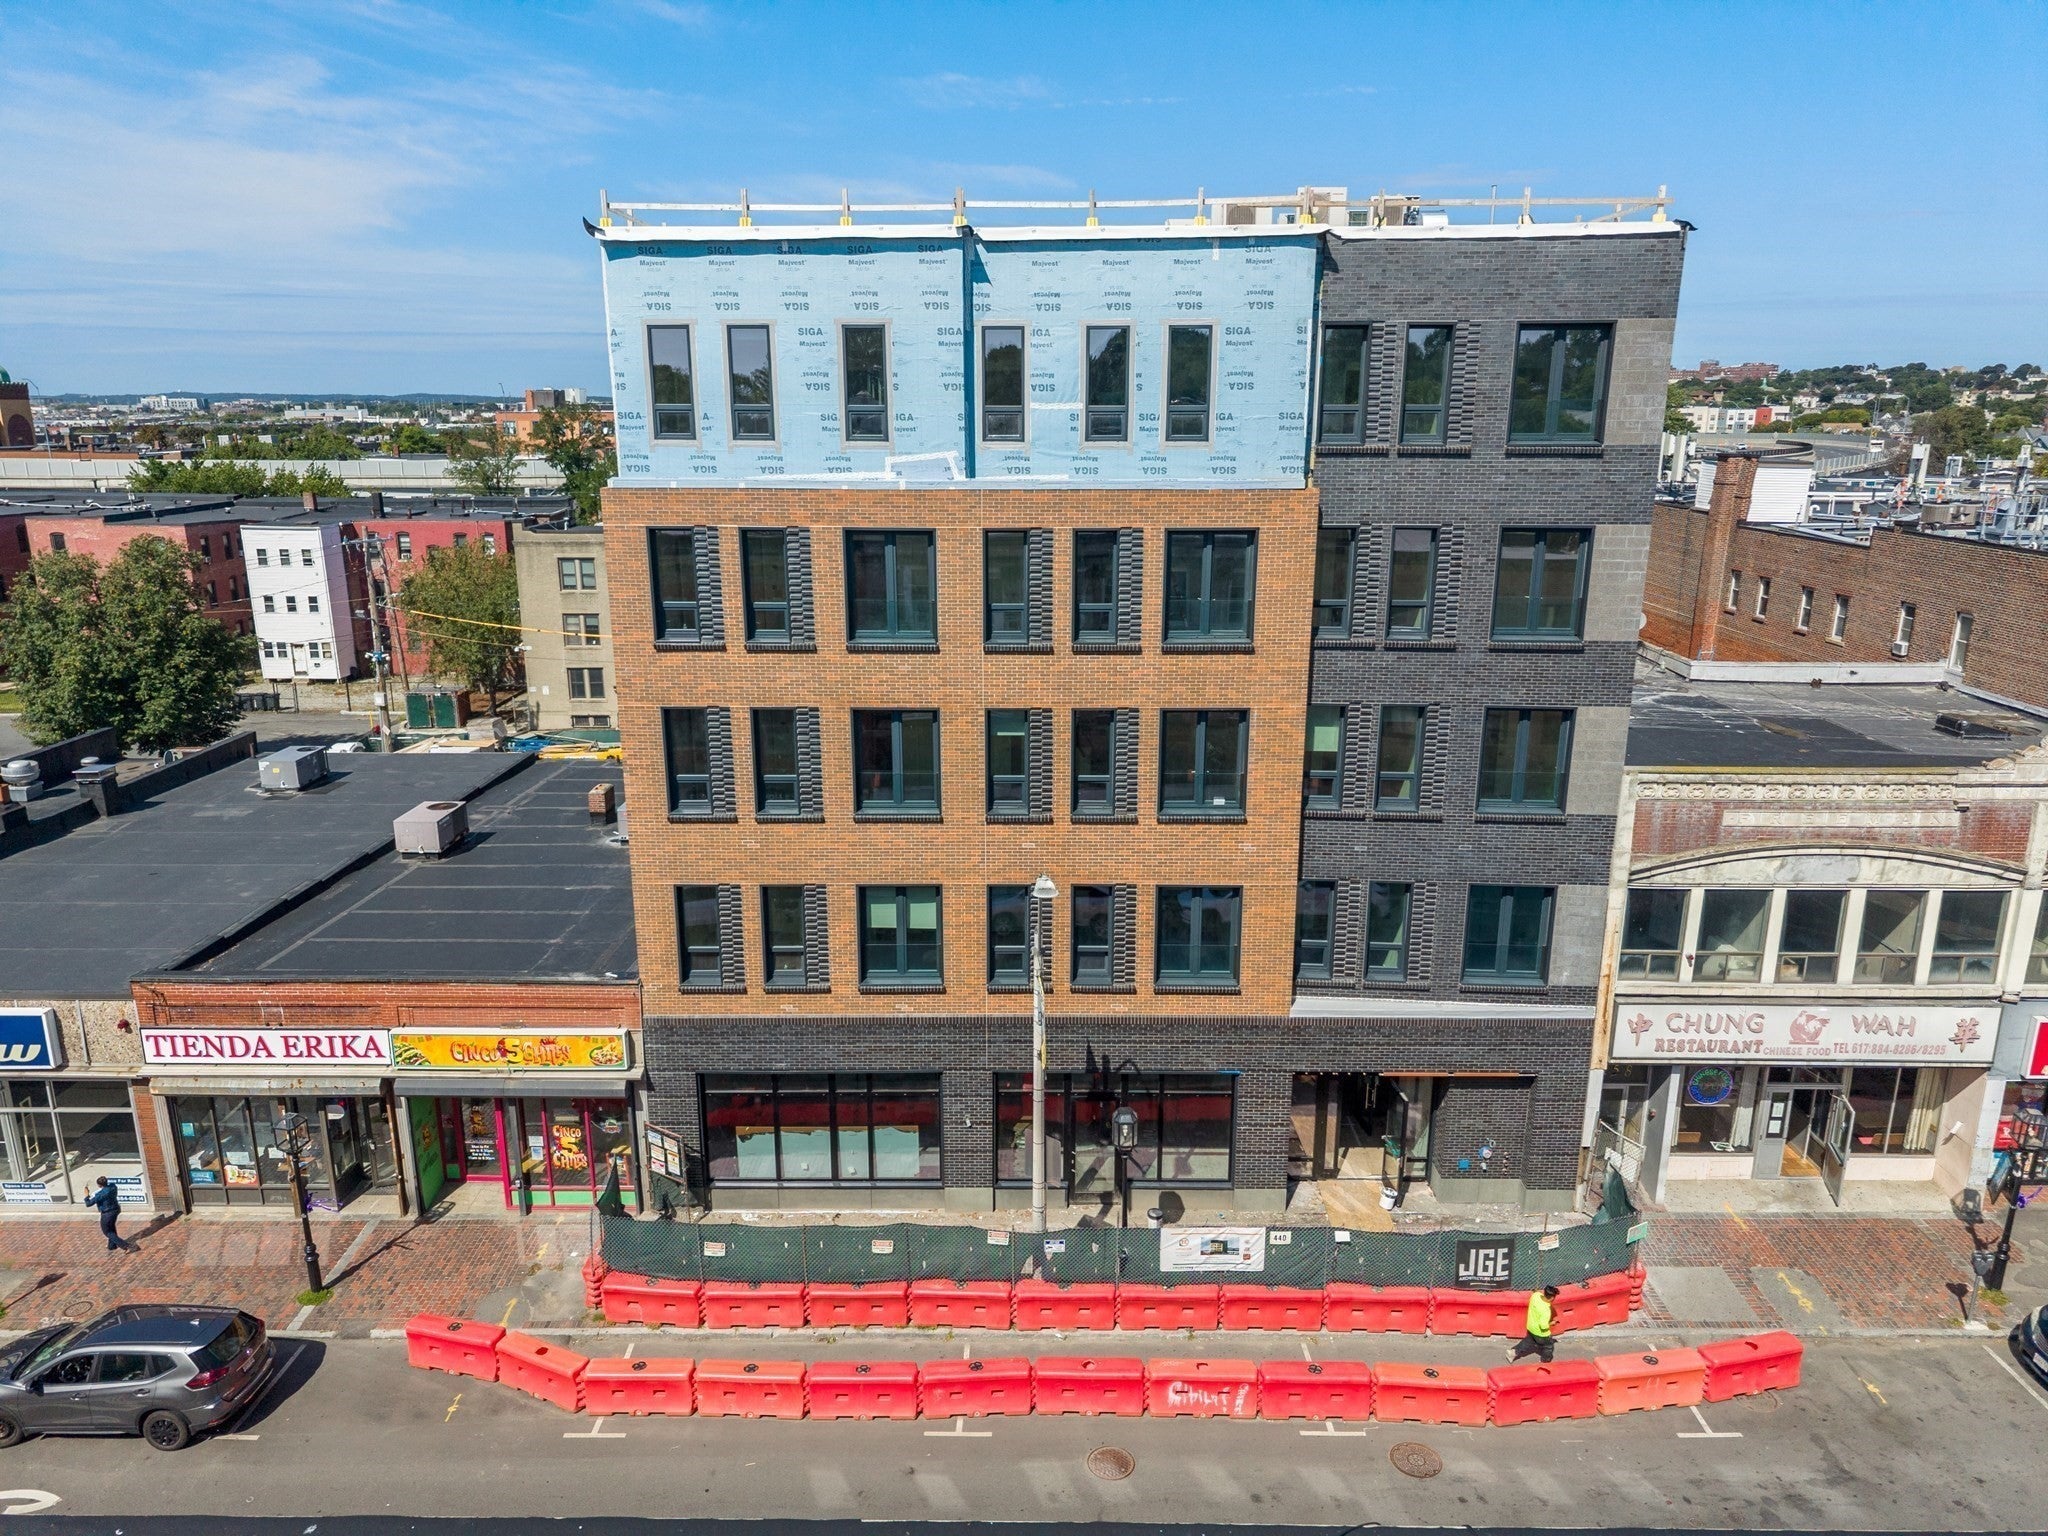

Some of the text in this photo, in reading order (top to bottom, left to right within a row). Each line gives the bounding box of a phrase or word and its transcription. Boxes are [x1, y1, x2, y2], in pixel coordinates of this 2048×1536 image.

[646, 302, 671, 311] SIGA
[715, 302, 740, 311] SIGA
[784, 302, 809, 311] SIGA
[854, 302, 879, 311] SIGA
[924, 301, 949, 310] SIGA
[973, 303, 991, 312] SIG
[1036, 303, 1061, 312] SIGA
[1106, 302, 1131, 311] SIGA
[1177, 301, 1202, 310] SIGA
[1248, 301, 1274, 310] SIGA
[797, 327, 823, 336] SIGA
[1030, 328, 1051, 337] IGA
[1225, 326, 1251, 336] SIGA
[805, 382, 830, 391] SIGA
[1031, 383, 1055, 392] SIGA
[1228, 382, 1254, 391] SIGA
[617, 411, 642, 421] SIGA
[820, 413, 838, 422] SIG
[895, 413, 914, 422] IGA
[1215, 412, 1234, 421] IGA
[626, 464, 650, 473] SIGA
[693, 465, 717, 474] SIGA
[760, 466, 784, 475] SIGA
[1006, 466, 1031, 475] SIGA
[1074, 466, 1099, 475] SIGA
[1142, 466, 1167, 475] SIGA
[1211, 466, 1236, 475] SIGA
[1627, 1012, 1653, 1047] 中
[1665, 1012, 1917, 1038] CHUNG WAH
[145, 1034, 386, 1059] TIENDA ERIKA
[1654, 1038, 1764, 1054] RESTAURANT
[1833, 1043, 1849, 1054] TEL
[1763, 1047, 1831, 1057] CHINESE FOOD
[552, 1124, 582, 1138] CINCO
[1273, 1234, 1287, 1242] 440
[1459, 1248, 1509, 1276] JGE
